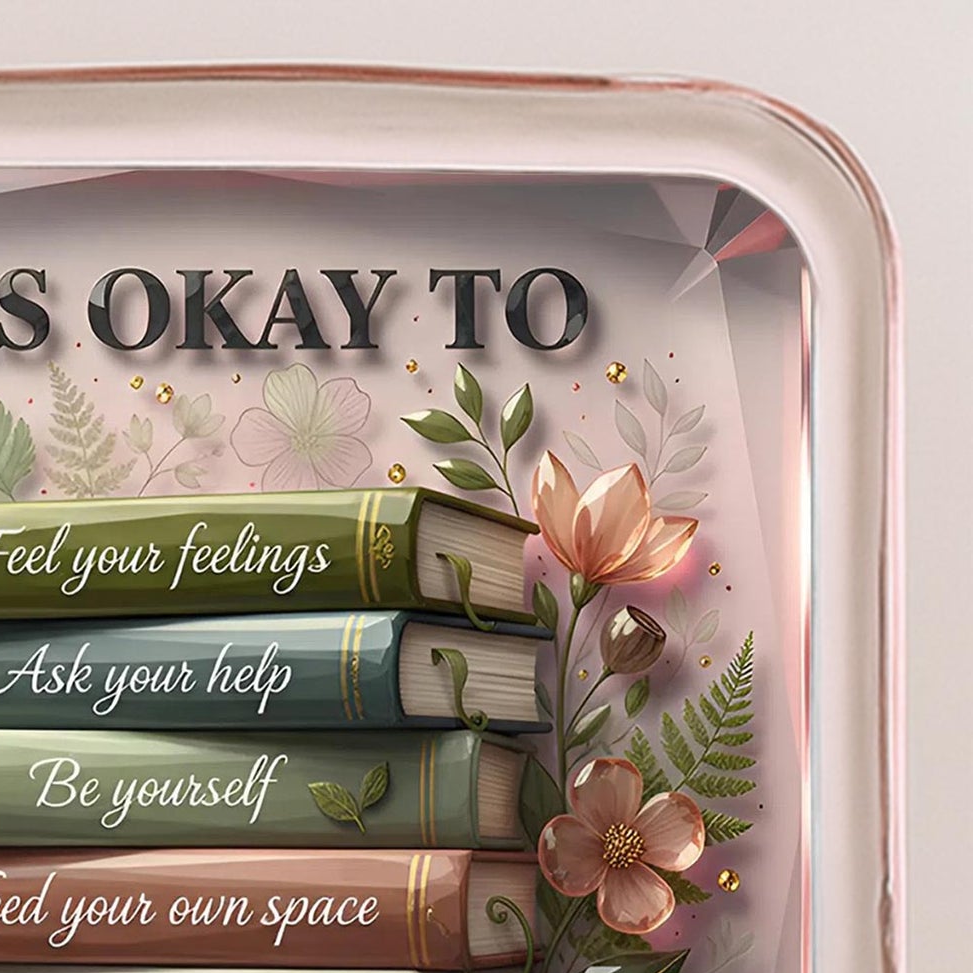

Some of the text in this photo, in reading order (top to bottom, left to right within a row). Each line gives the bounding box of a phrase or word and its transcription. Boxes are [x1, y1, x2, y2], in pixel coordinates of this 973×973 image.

[87, 267, 397, 351] OKAY
[430, 267, 589, 351] TO
[61, 544, 165, 596] your
[170, 522, 330, 594] feelings
[92, 660, 196, 714] your
[207, 643, 292, 713] help
[28, 755, 288, 828] Be yourself
[49, 892, 156, 946] your
[168, 892, 254, 925] own
[259, 890, 379, 946] space
